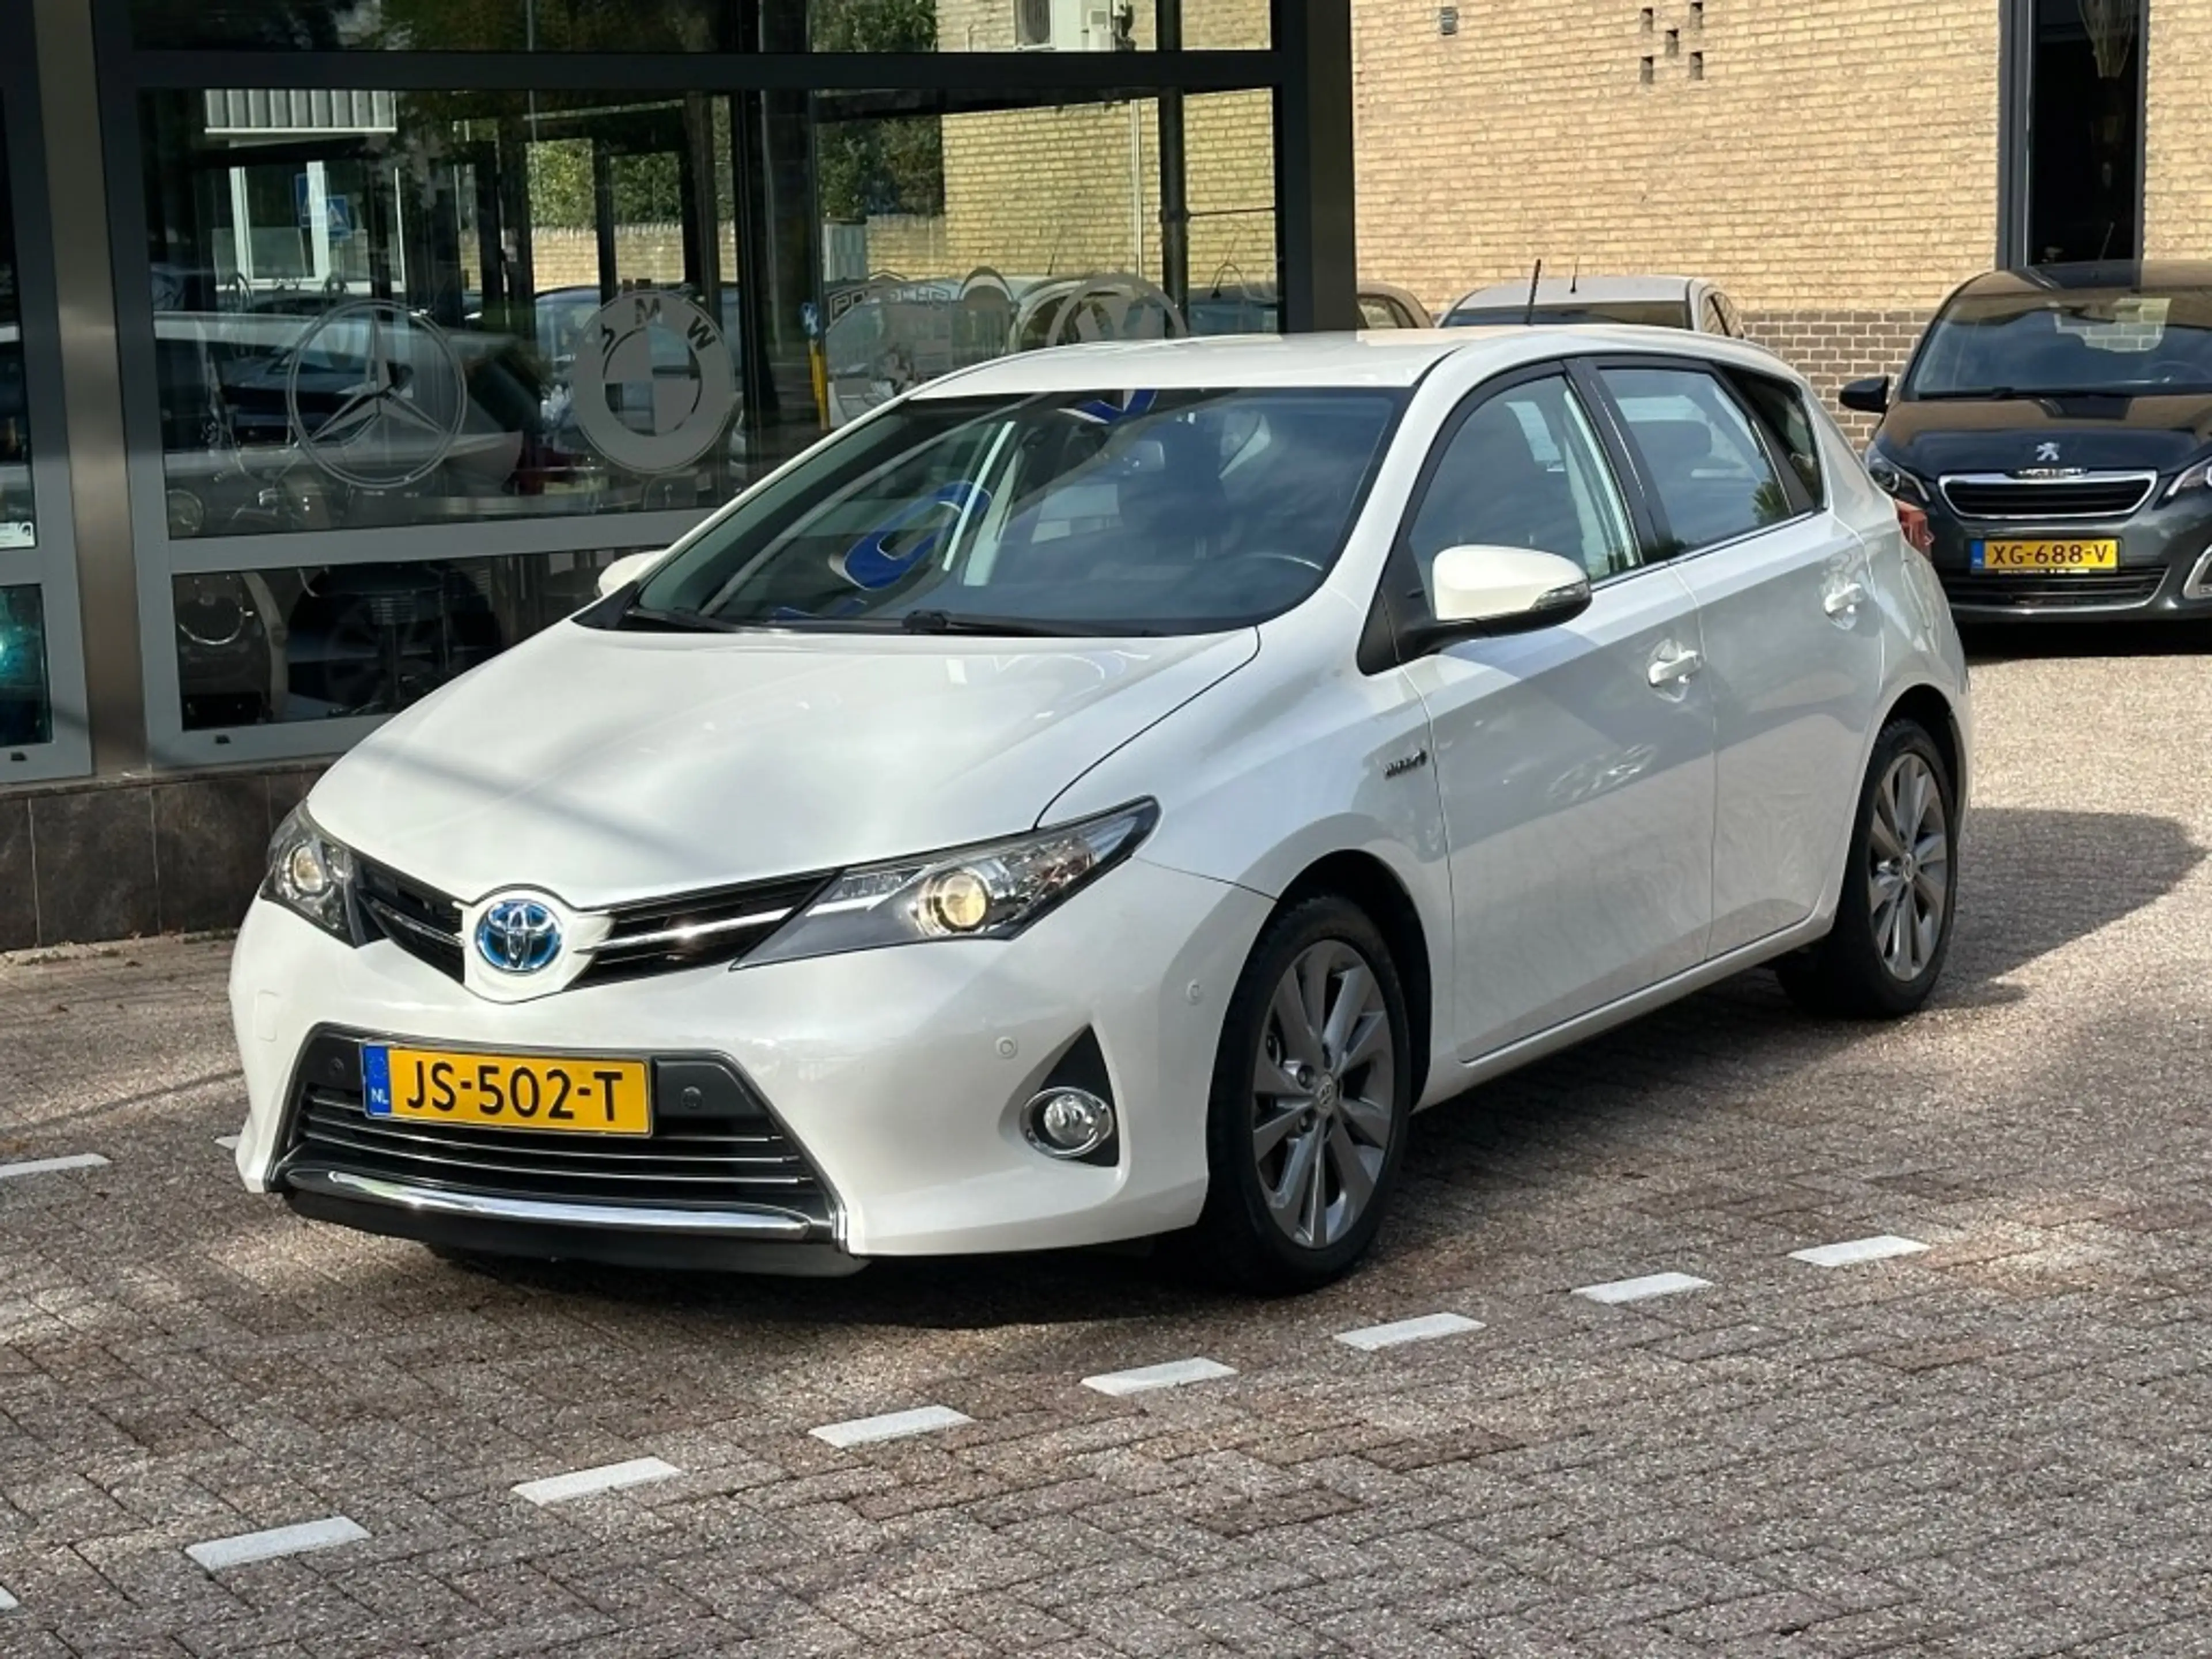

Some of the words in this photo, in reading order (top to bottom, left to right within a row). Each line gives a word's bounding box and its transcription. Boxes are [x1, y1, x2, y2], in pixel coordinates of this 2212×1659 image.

[1992, 544, 2108, 565] XG-688-V
[370, 1086, 389, 1105] NL
[406, 1060, 623, 1122] JS-502-T
